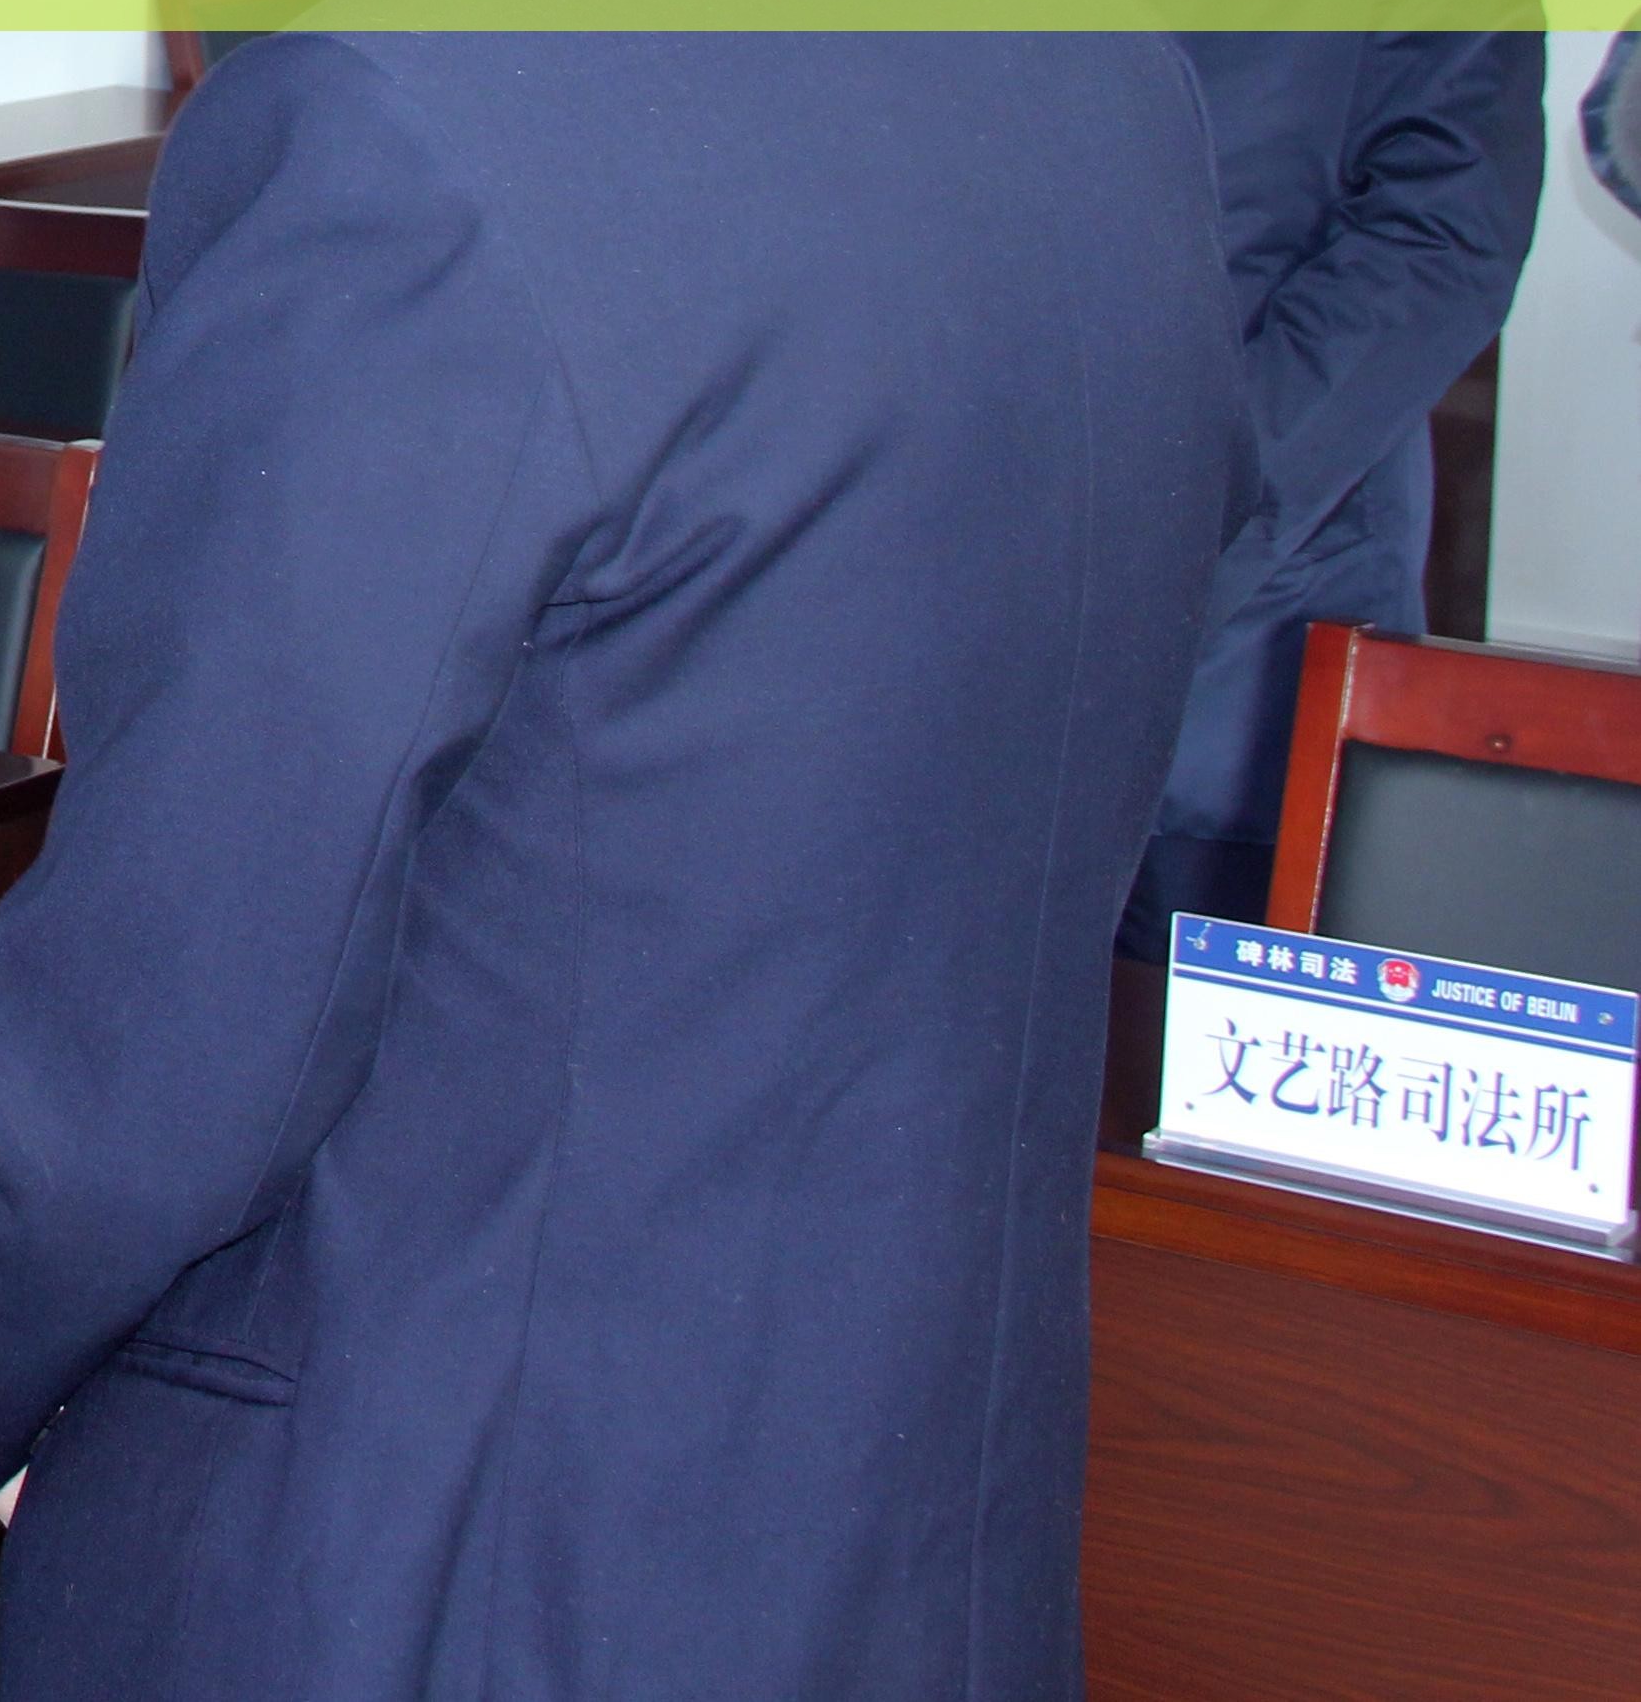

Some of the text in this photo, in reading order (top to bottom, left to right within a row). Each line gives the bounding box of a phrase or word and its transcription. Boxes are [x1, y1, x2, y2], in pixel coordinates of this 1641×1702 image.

[1235, 938, 1358, 985] 碑林司法
[1431, 978, 1580, 1024] JUSTICE OF BEILIN
[1201, 1017, 1591, 1171] 文艺路司法所
